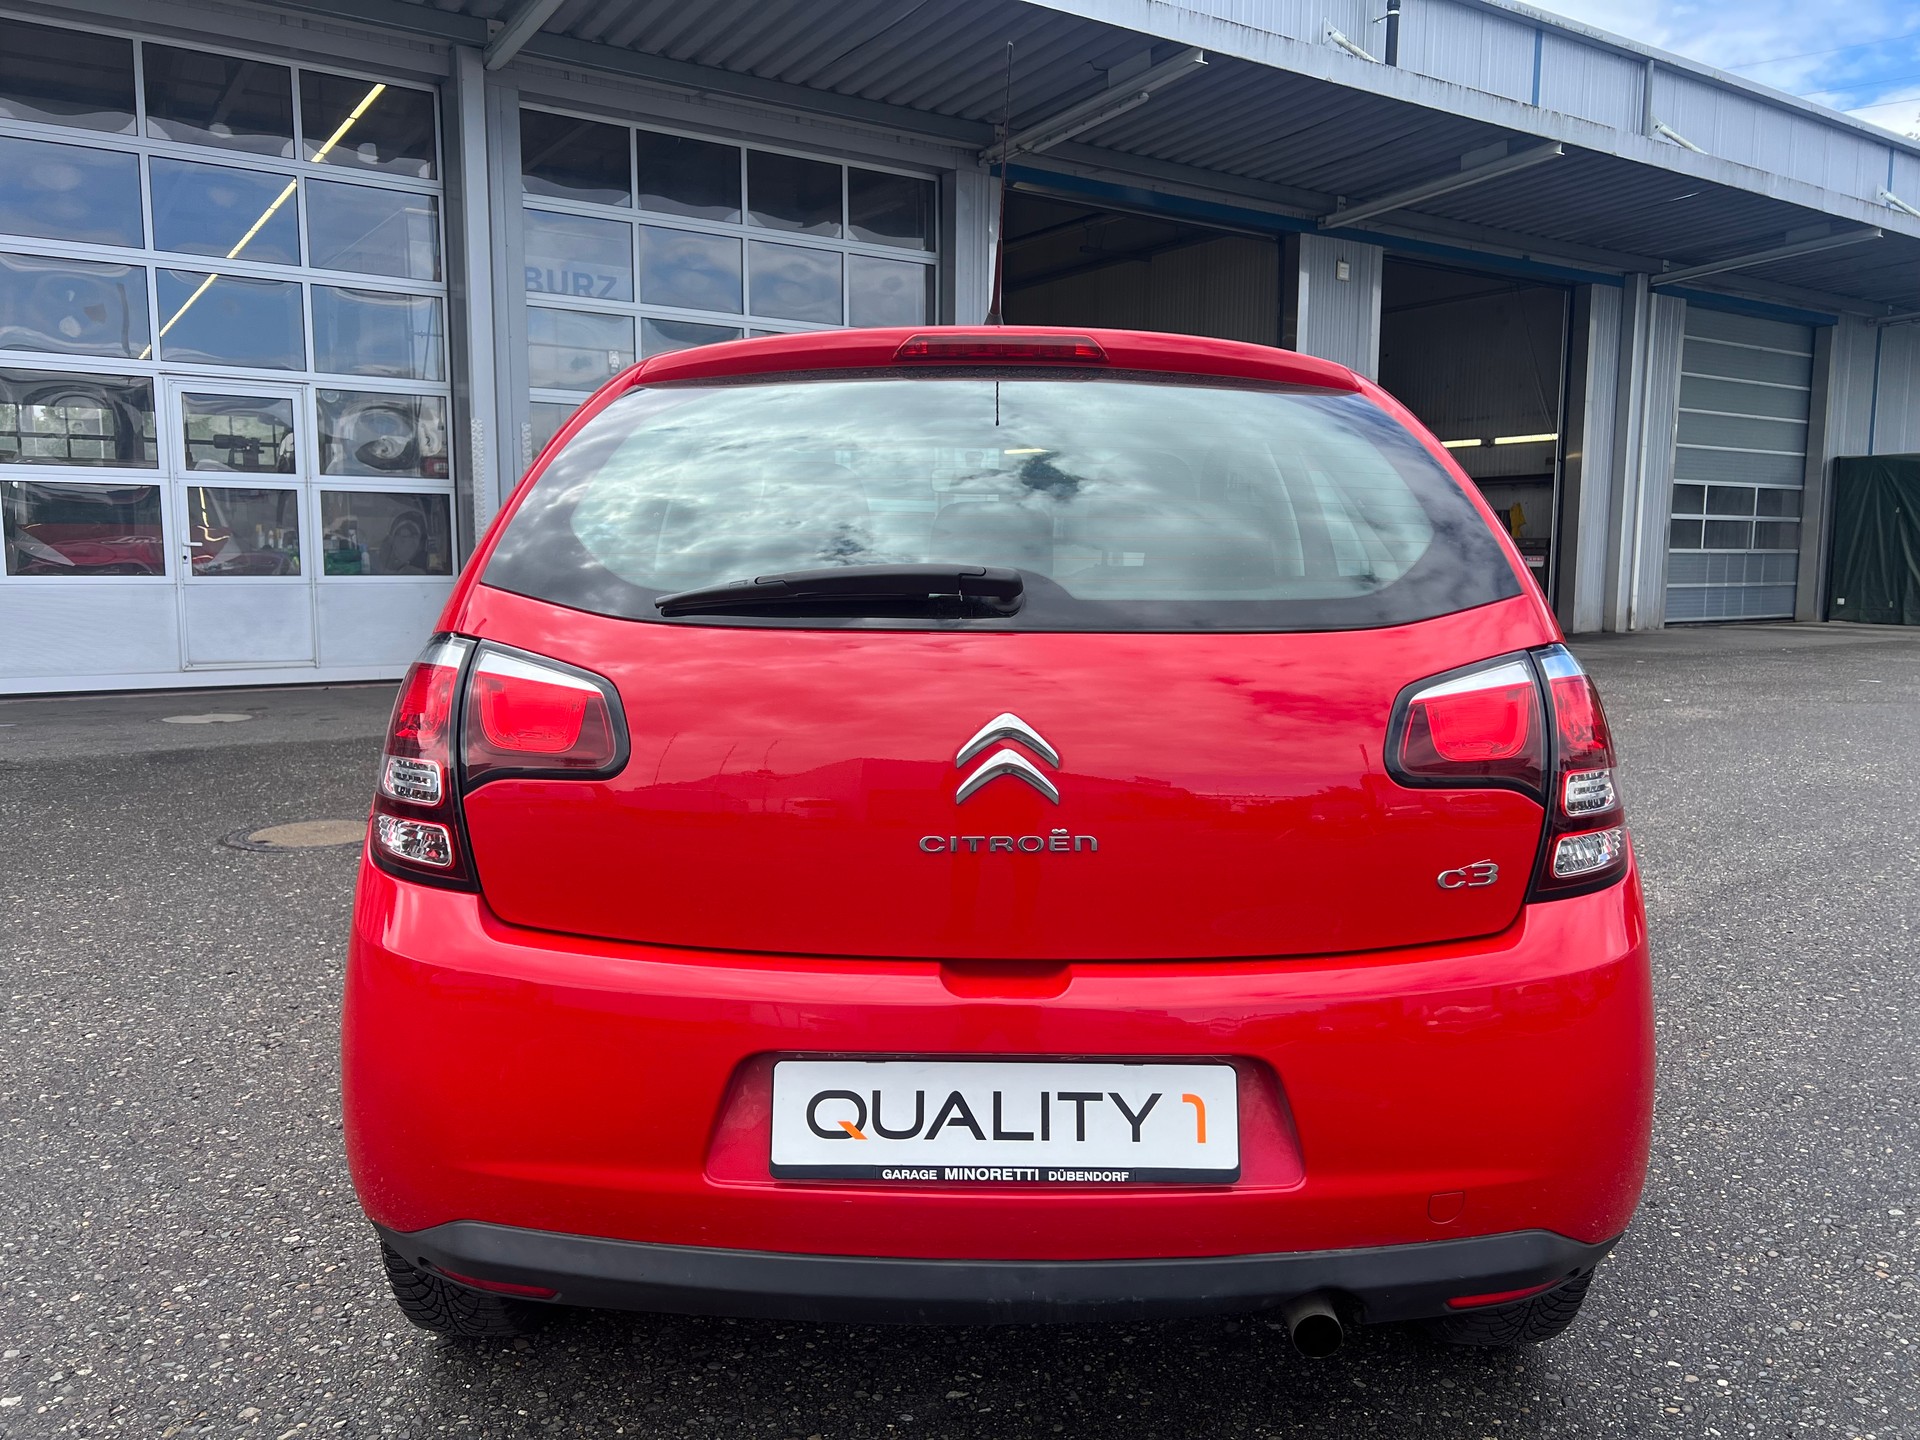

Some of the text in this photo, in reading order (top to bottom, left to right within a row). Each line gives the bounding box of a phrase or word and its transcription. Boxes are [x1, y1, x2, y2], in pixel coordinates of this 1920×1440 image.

[525, 266, 618, 299] BURZ
[1437, 859, 1499, 889] C3
[806, 1090, 1206, 1144] QUALITY 1
[882, 1168, 1130, 1182] GARAGE MINORETTI DÜBENDORF
